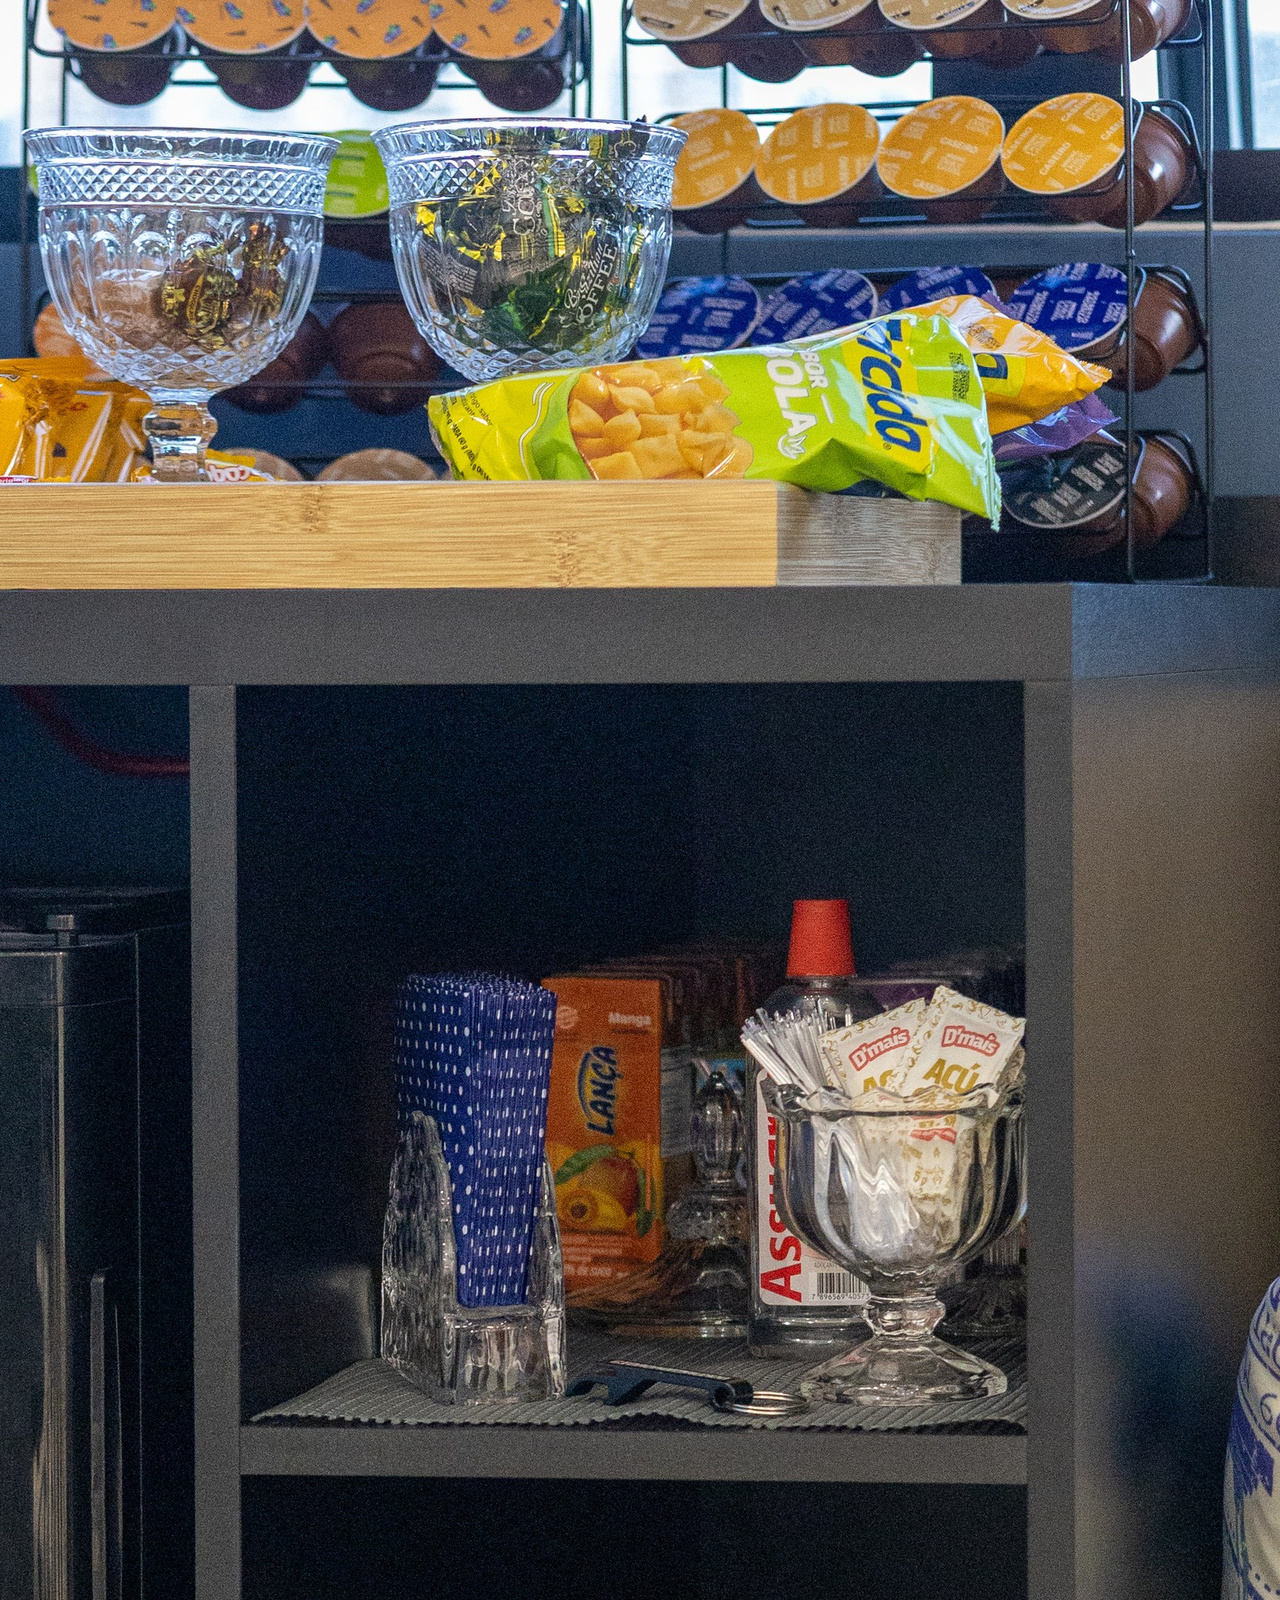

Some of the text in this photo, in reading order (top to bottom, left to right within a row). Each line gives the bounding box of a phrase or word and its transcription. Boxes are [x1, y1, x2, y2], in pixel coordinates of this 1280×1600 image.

[1039, 142, 1071, 176] CASEIRO
[857, 318, 923, 453] rcida
[849, 1026, 912, 1071] D'mais
[941, 1025, 1000, 1057] D'mais
[586, 1045, 623, 1136] LANÇA
